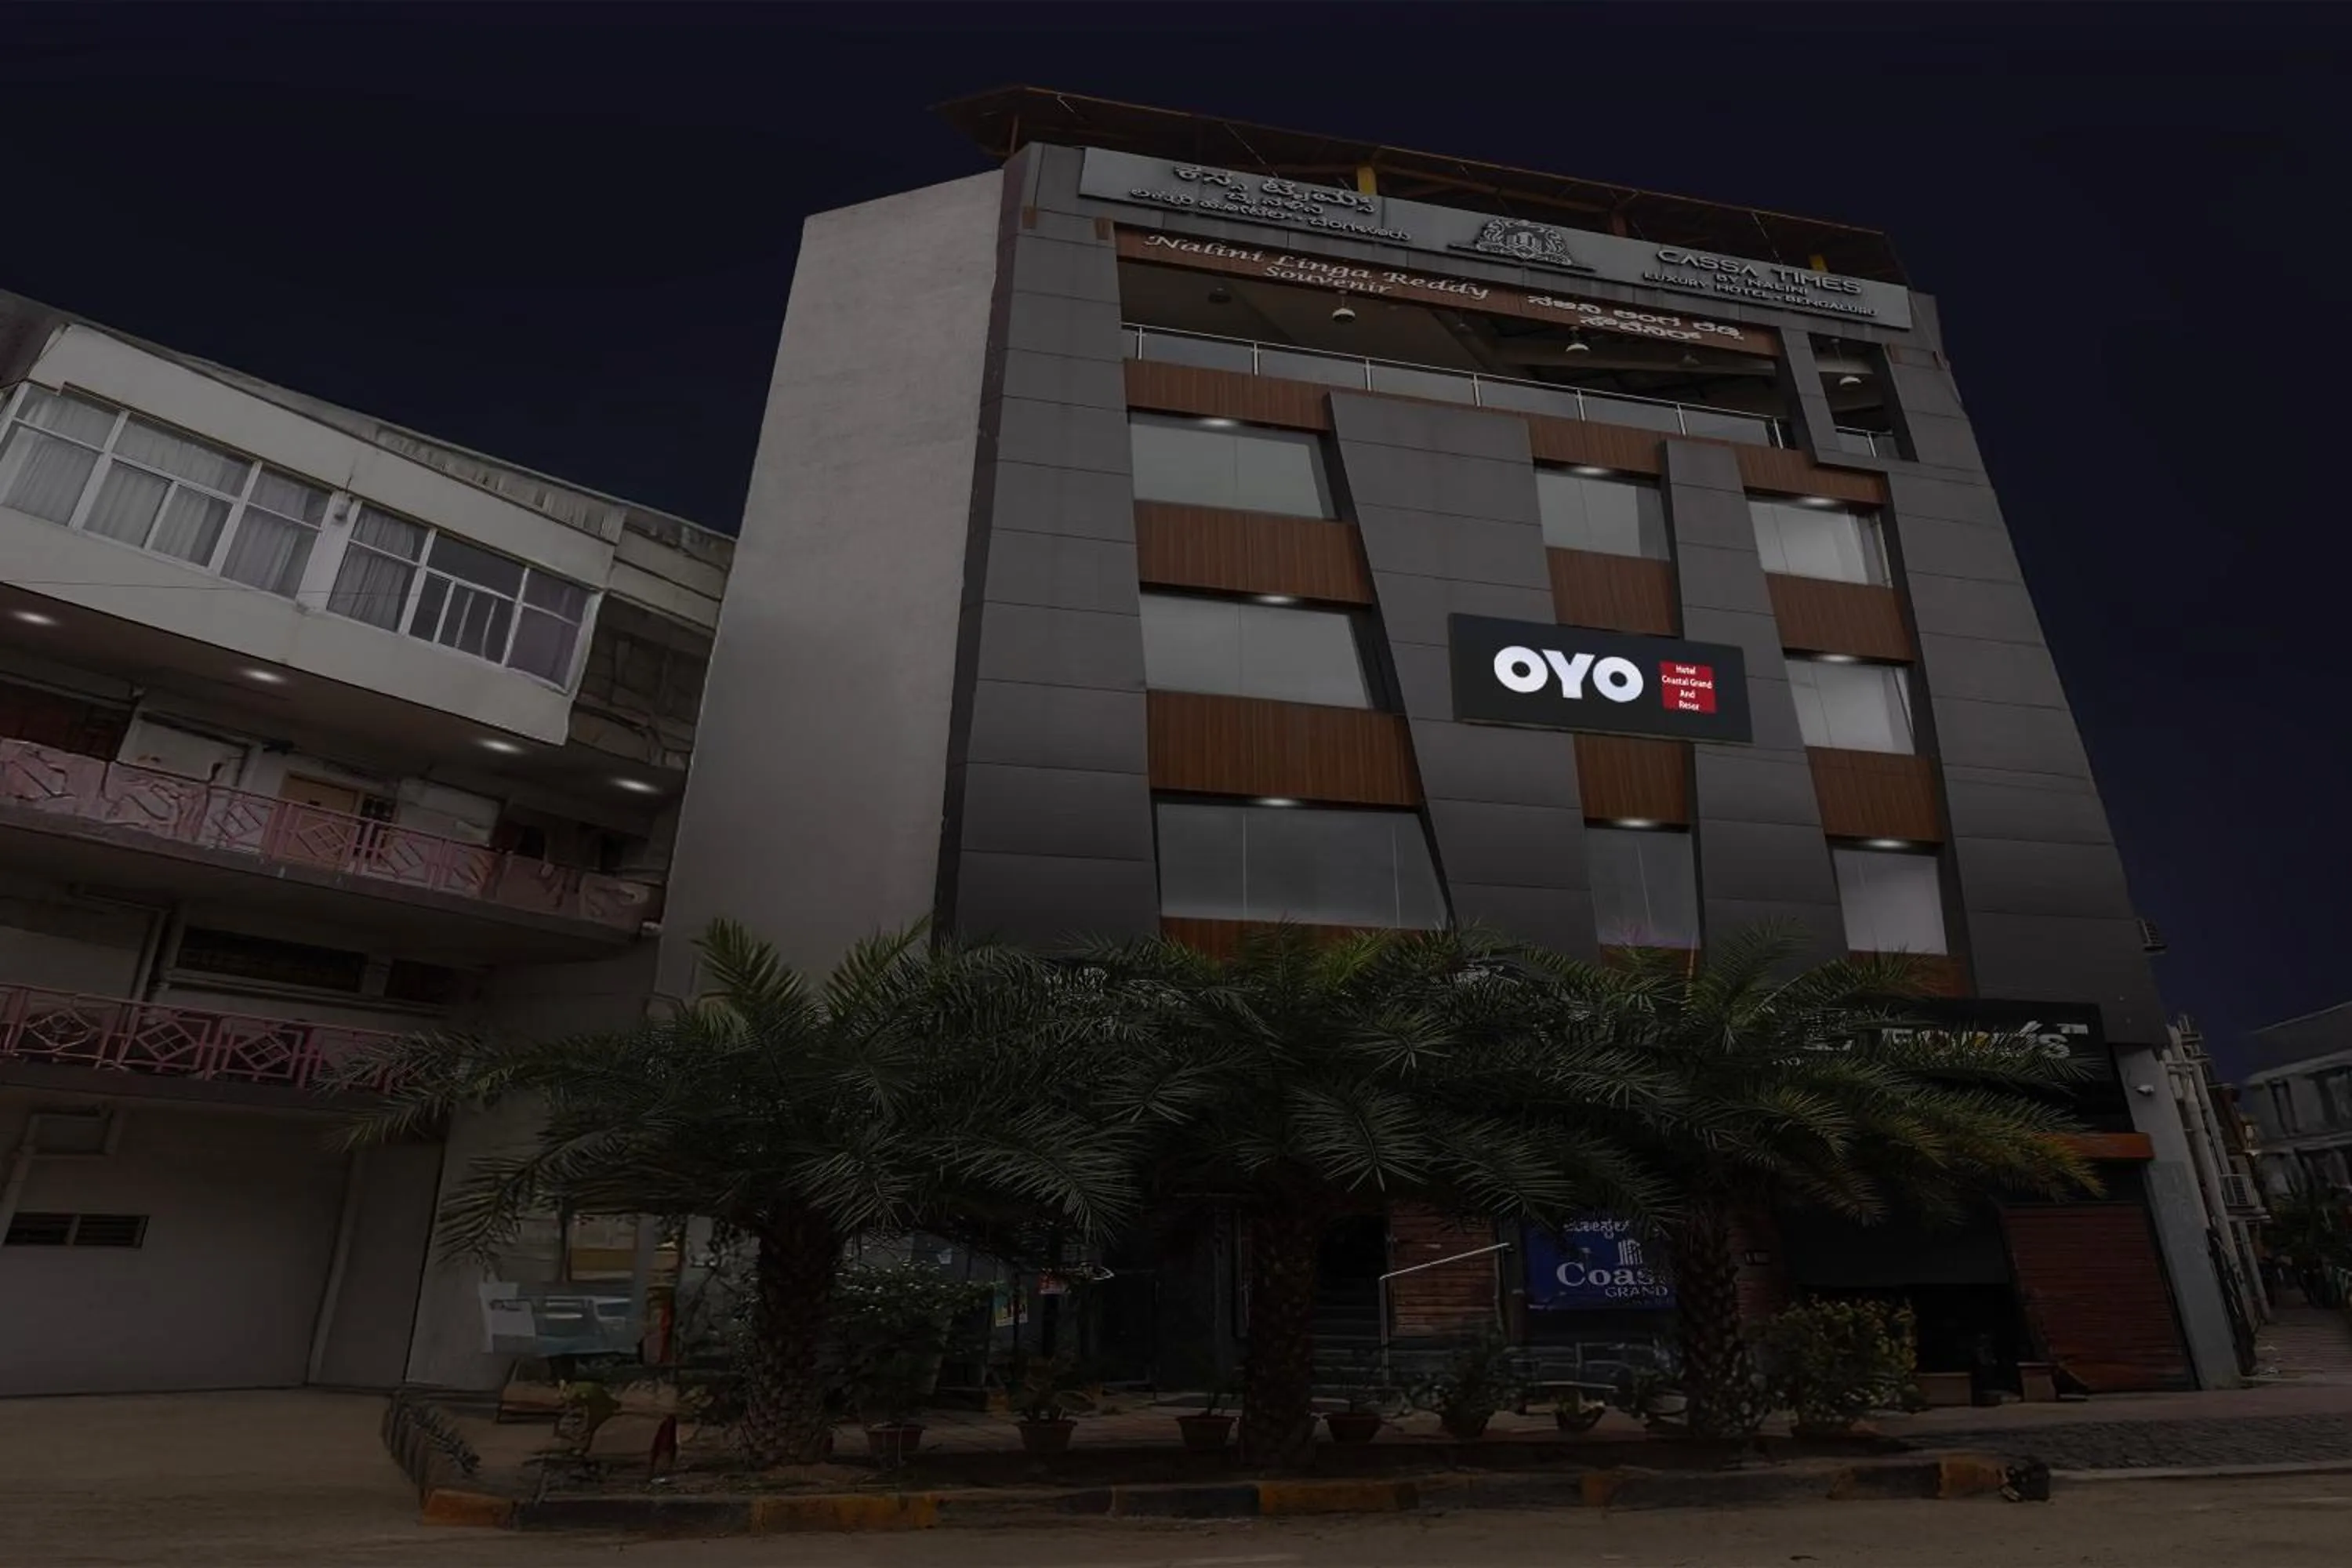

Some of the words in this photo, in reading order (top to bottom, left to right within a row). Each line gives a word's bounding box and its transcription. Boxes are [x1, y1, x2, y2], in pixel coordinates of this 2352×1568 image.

[1142, 233, 1265, 264] Nalini
[1276, 253, 1373, 281] Linga
[1382, 270, 1490, 300] Reddy
[1657, 249, 1758, 276] CASSA
[1772, 268, 1862, 295] TIMES
[1264, 267, 1393, 295] Souvenir
[1715, 274, 1740, 284] BY
[1748, 278, 1809, 296] NALINI
[1643, 271, 1708, 289] LUXURY
[1715, 284, 1769, 300] HOTEL
[1784, 294, 1879, 317] BENGALURU
[1494, 645, 1644, 703] OYO
[1661, 675, 1689, 685] Coastal
[1690, 679, 1713, 689] Grand
[1675, 665, 1696, 674] Hotel
[1680, 689, 1696, 699] And
[1605, 1286, 1668, 1298] GRAND
